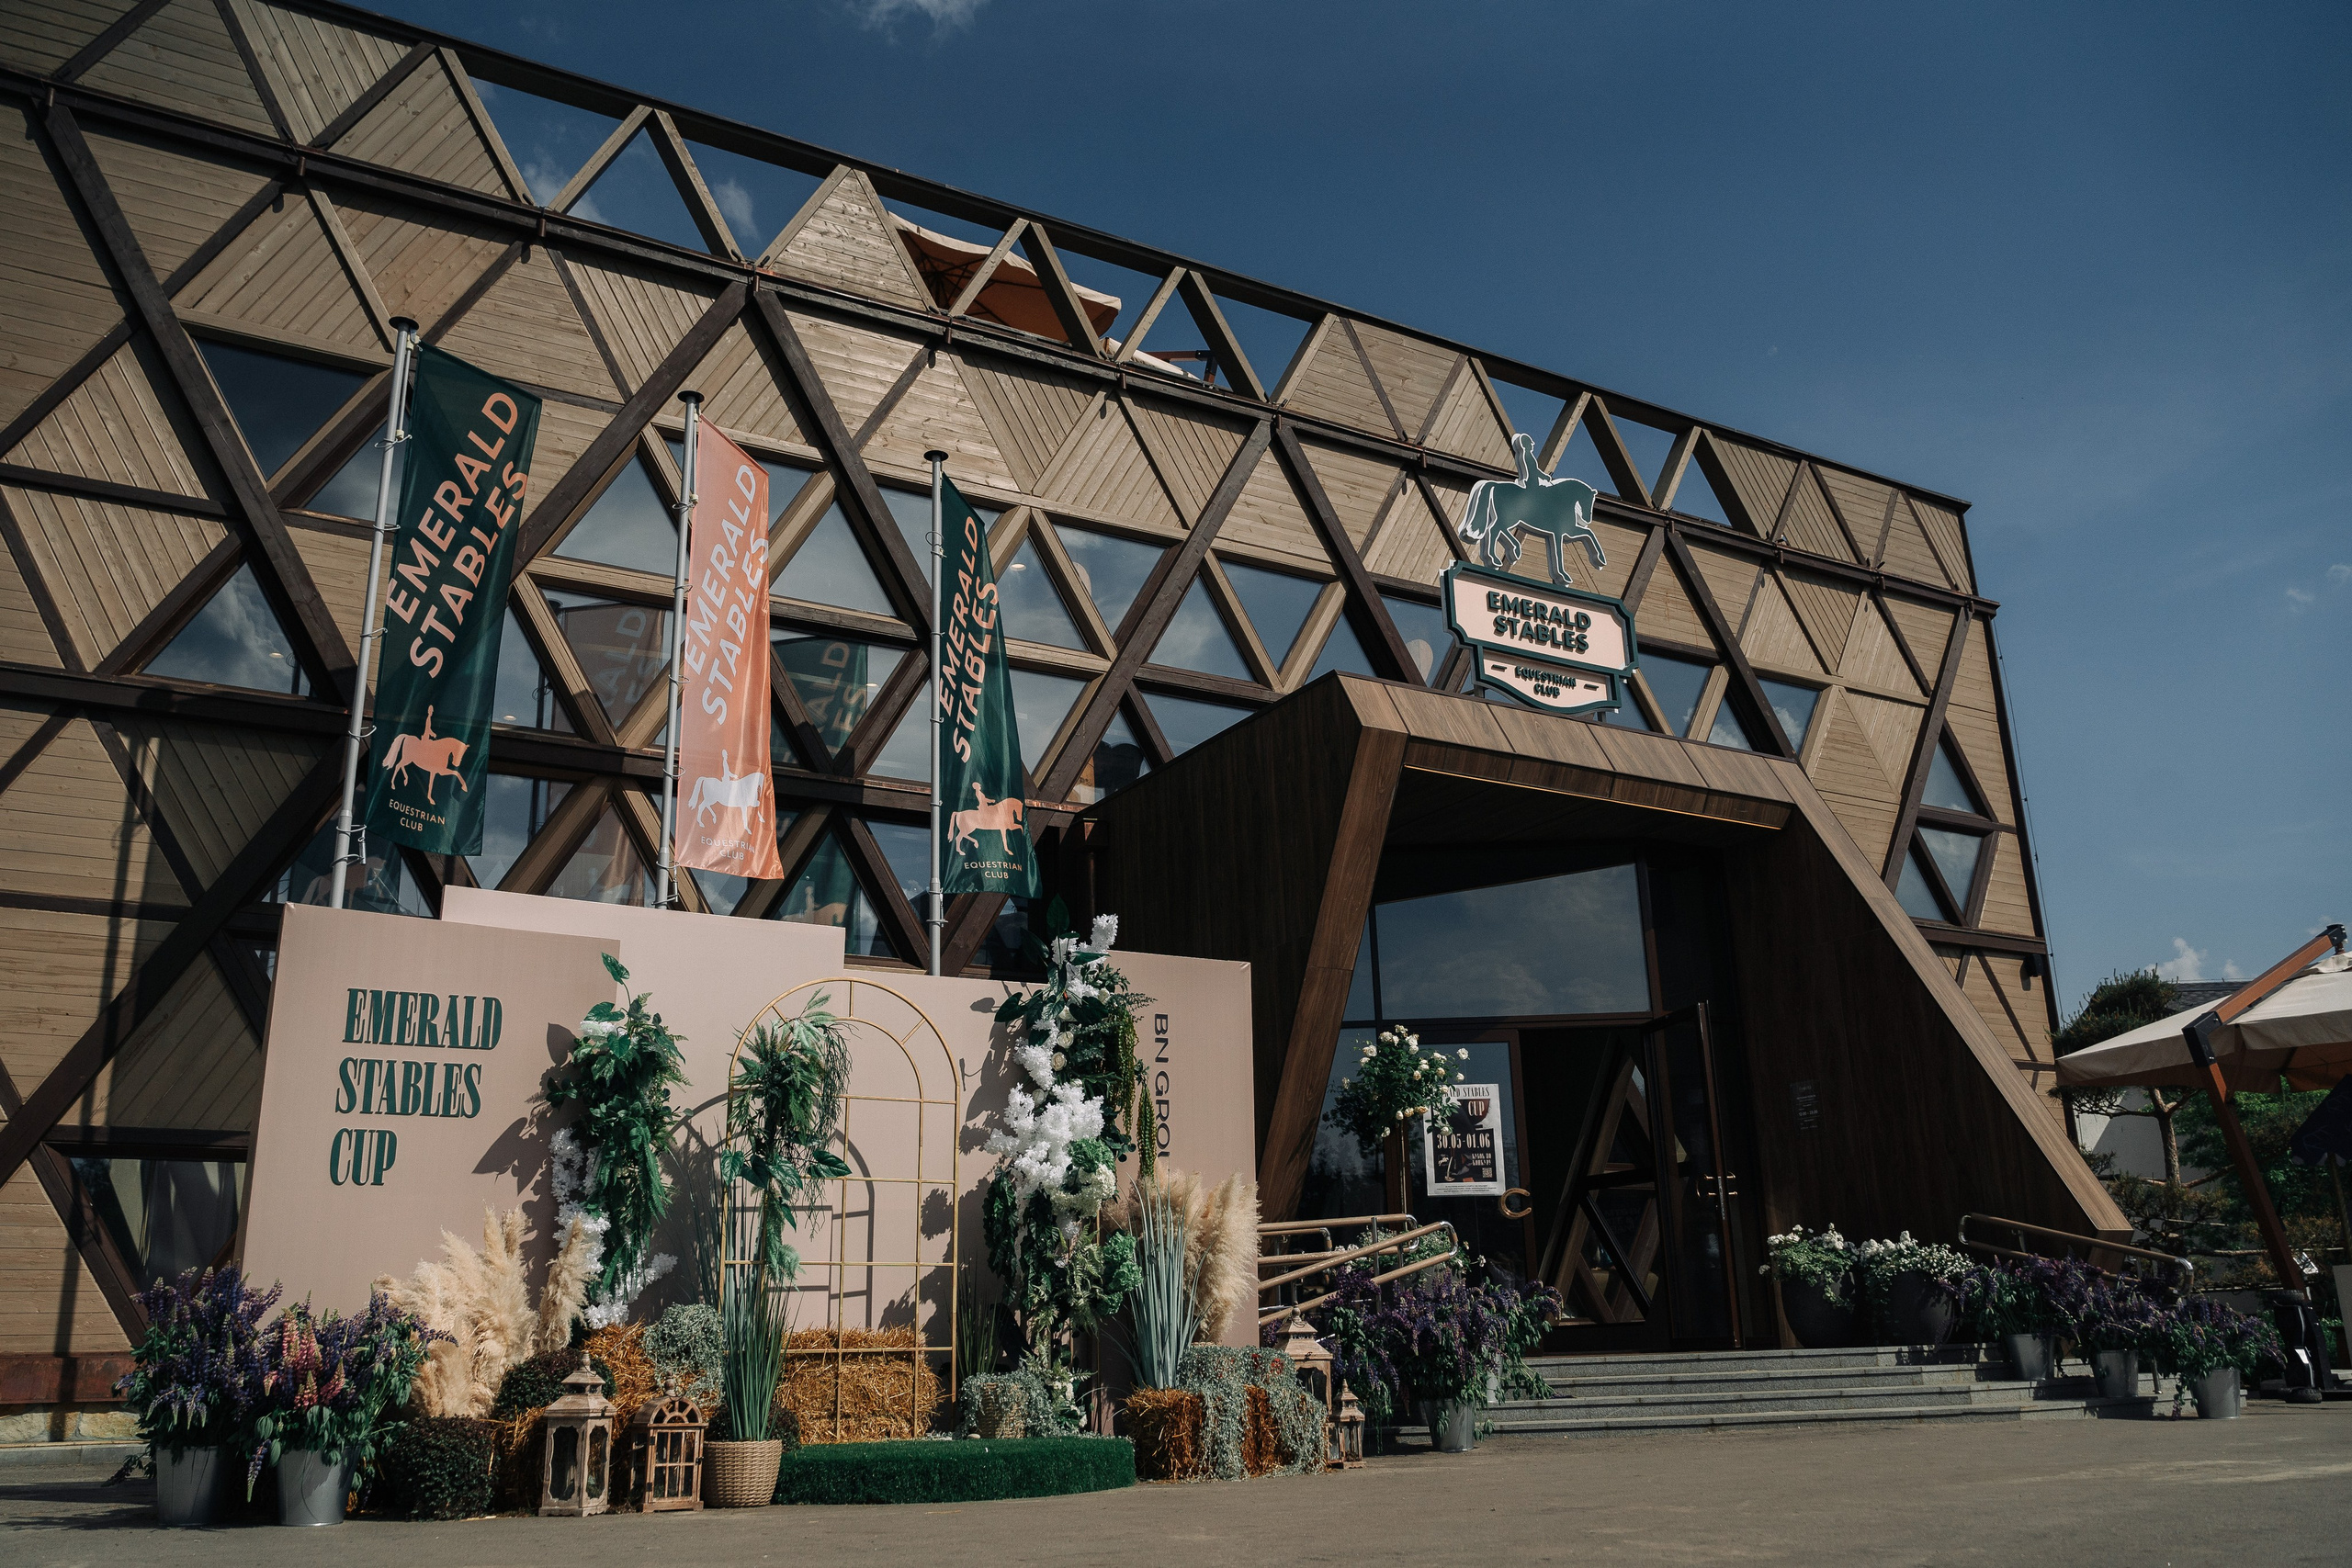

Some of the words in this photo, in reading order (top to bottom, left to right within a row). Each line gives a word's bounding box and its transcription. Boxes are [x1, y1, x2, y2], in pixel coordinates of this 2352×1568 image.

[386, 391, 518, 625] EMERALD
[410, 460, 528, 679] STABLES
[685, 464, 756, 677] EMERALD
[939, 515, 978, 717] EMERALD
[1487, 591, 1591, 631] EMERALD
[702, 535, 768, 726] STABLES
[1494, 615, 1589, 653] STABLES
[953, 577, 1001, 763] STABLES
[1515, 666, 1577, 688] EQUESTRIAN
[1533, 683, 1560, 698] CLUB
[389, 798, 446, 825] EQUESTRIAN
[400, 817, 424, 831] CLUB
[701, 836, 755, 853] EQUESTRIAN
[719, 850, 744, 861] CLUB
[964, 861, 1023, 872] EQUESTRIAN
[984, 871, 1009, 879] CLUB
[342, 987, 503, 1051] EMERALD
[1154, 1013, 1169, 1063] BN
[335, 1056, 482, 1119] STABLES
[1463, 1087, 1490, 1097] STABLES
[1468, 1100, 1485, 1117] CUP
[329, 1127, 398, 1186] CUP
[1436, 1133, 1491, 1149] 30.05-01.06
